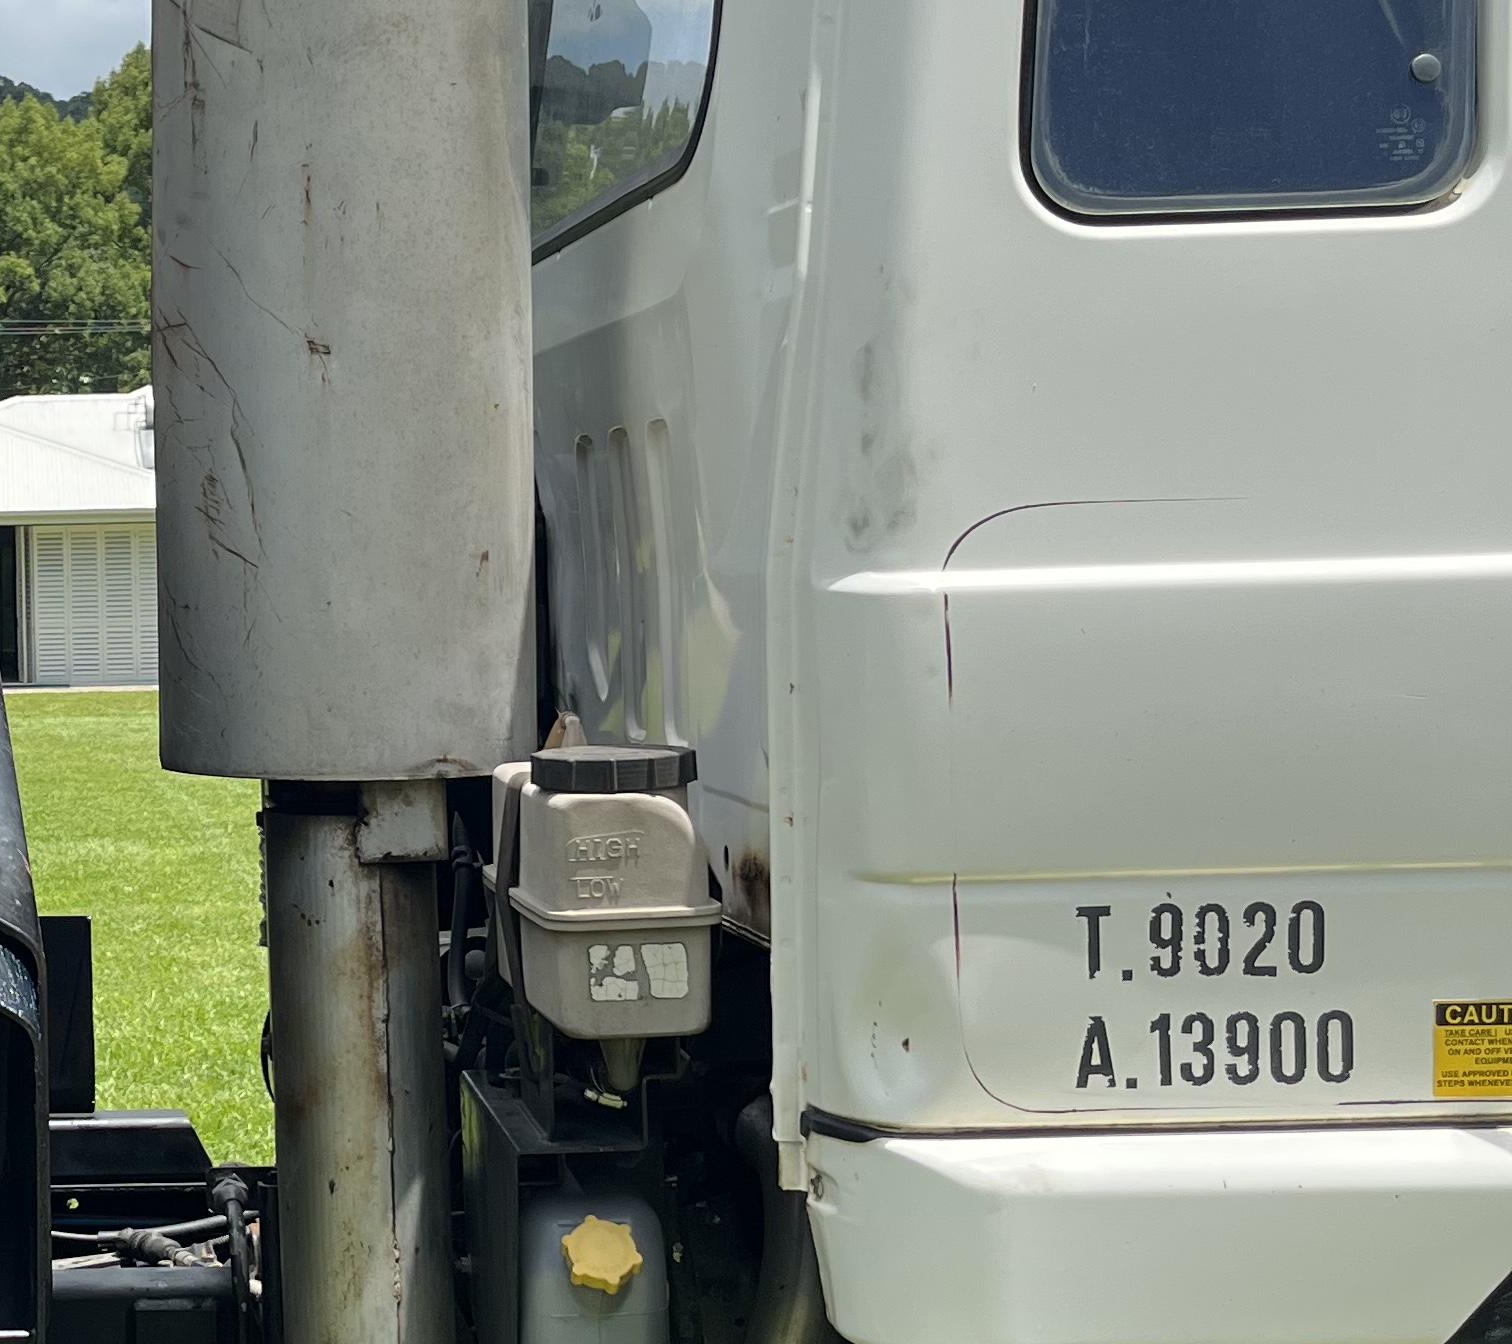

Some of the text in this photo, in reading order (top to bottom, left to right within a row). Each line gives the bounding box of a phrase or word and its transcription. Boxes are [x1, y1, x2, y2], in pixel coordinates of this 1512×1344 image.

[575, 837, 640, 862] HIGH
[577, 878, 624, 898] LOW
[1076, 901, 1325, 981] T.9020
[1445, 1038, 1485, 1046] CONTACT
[1076, 1010, 1354, 1089] A.13900
[1463, 1047, 1482, 1055] AND
[1484, 1047, 1501, 1055] OFF
[1462, 1069, 1509, 1077] APPROVED
[1436, 1079, 1465, 1087] STEPS
